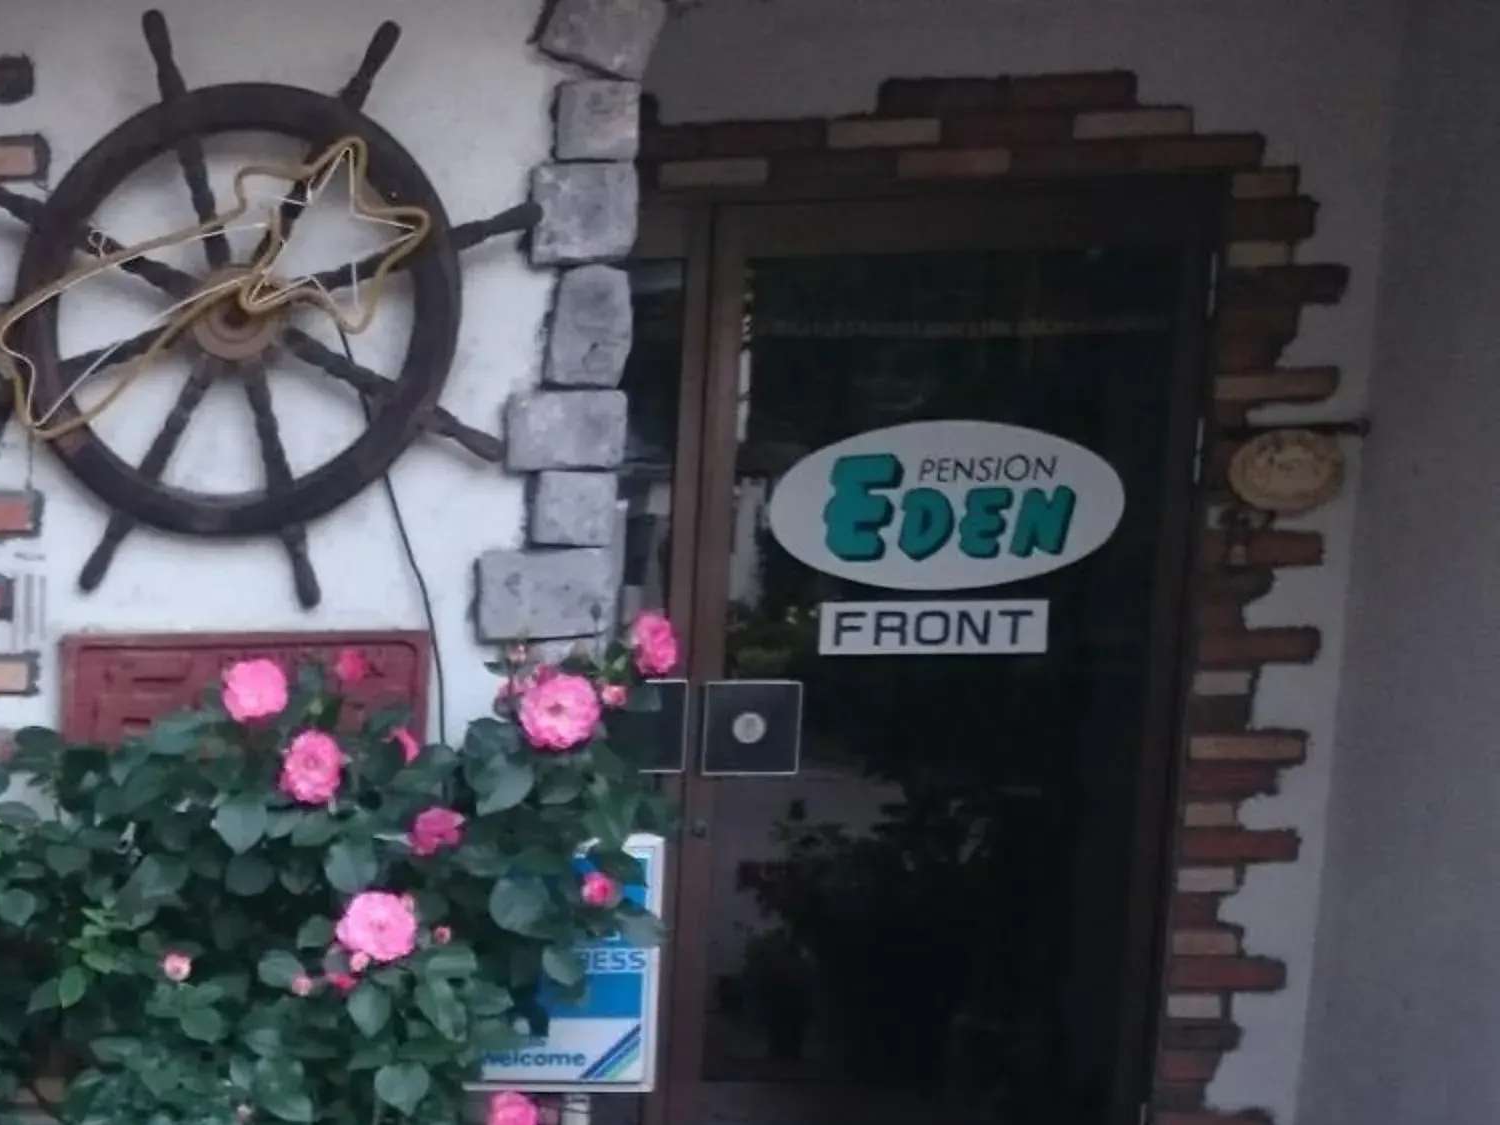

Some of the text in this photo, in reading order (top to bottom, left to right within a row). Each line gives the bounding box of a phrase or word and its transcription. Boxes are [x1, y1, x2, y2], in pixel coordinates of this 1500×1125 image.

[918, 454, 1058, 482] PENSION
[823, 453, 1077, 562] EDEN
[833, 610, 1033, 647] FRONT
